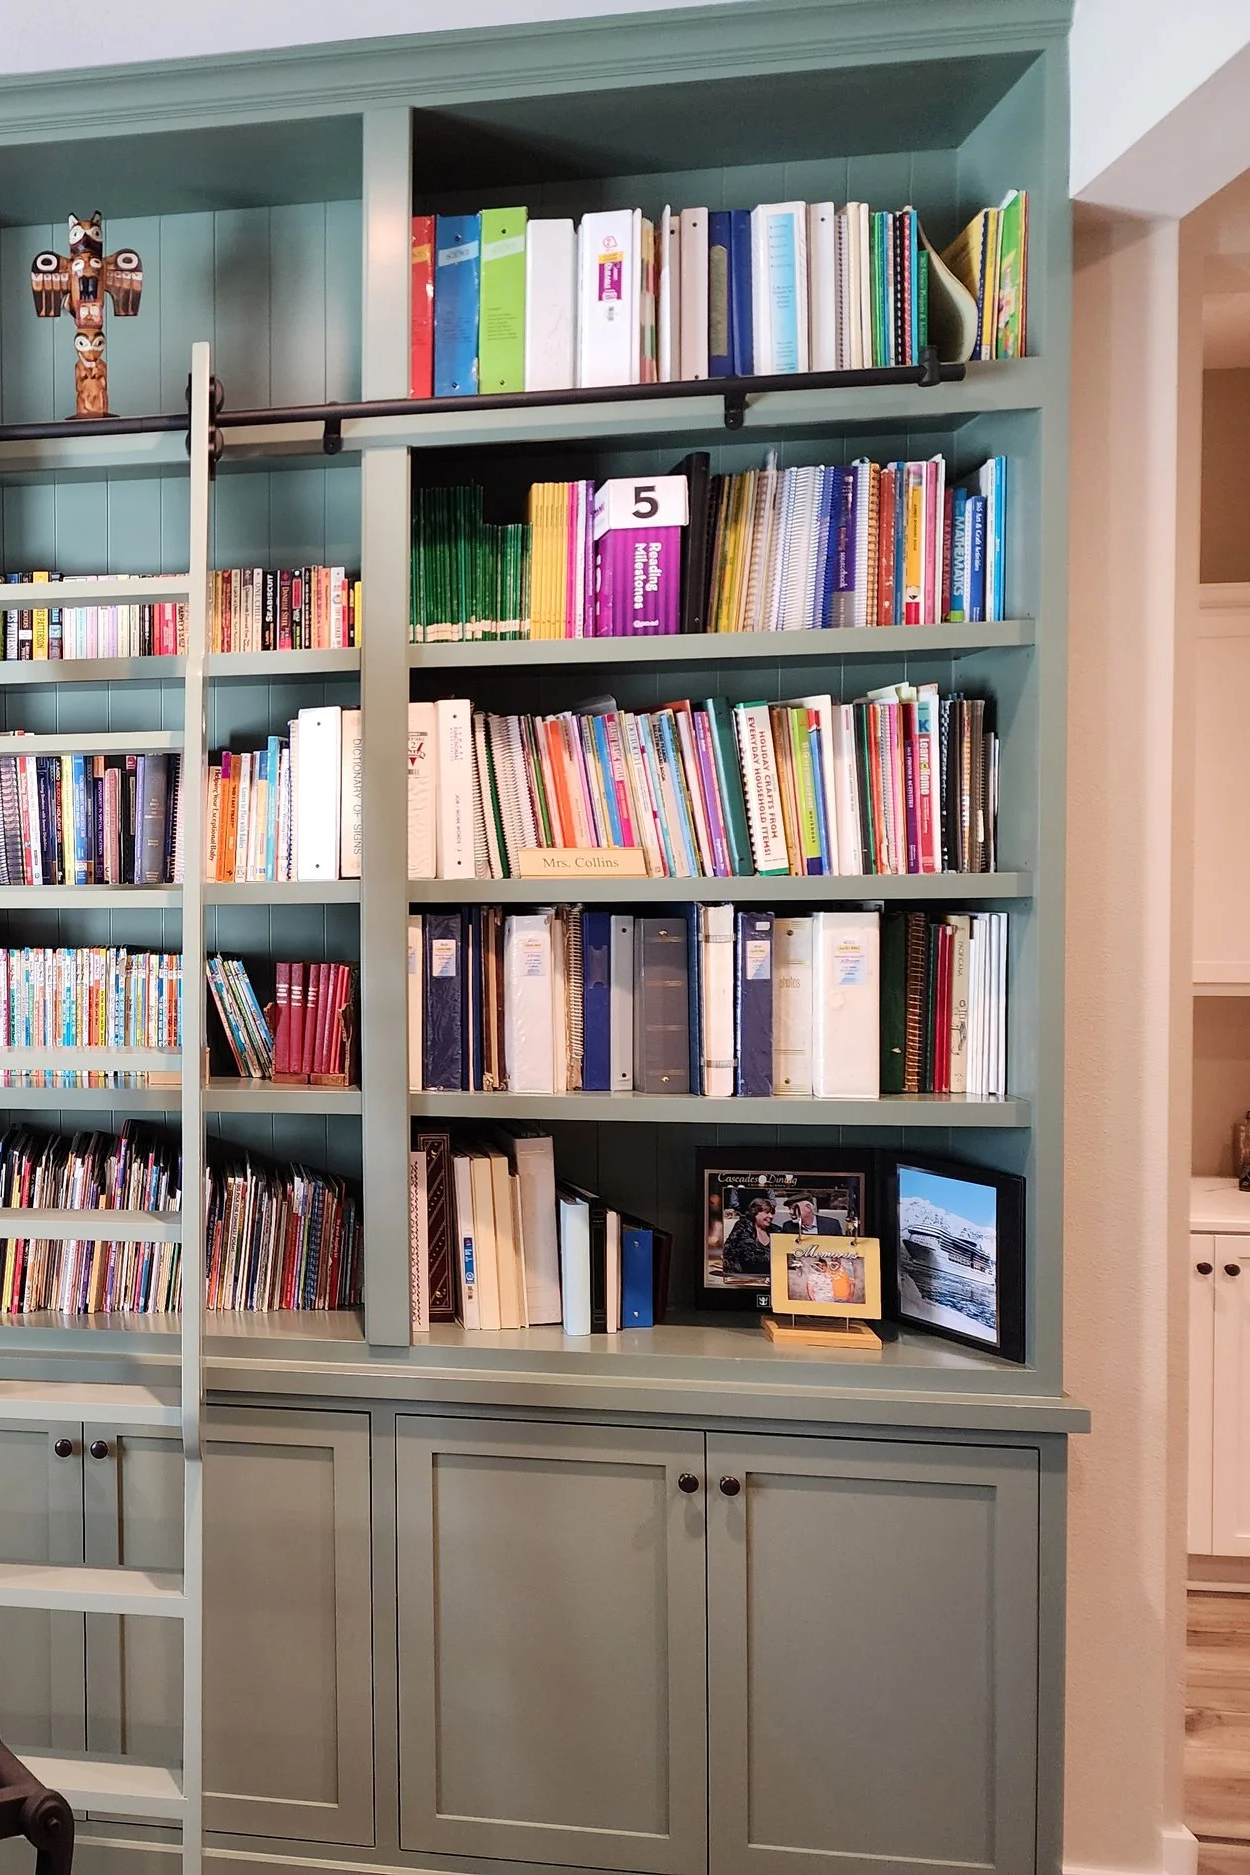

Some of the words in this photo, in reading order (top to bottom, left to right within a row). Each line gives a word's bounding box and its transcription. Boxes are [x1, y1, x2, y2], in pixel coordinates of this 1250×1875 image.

[632, 486, 658, 519] 5
[646, 542, 662, 592] Reading
[840, 552, 848, 588] sourcebook
[954, 517, 966, 596] MATHEMATICS
[634, 543, 647, 610] Milestones
[266, 574, 274, 622] SEABISCUIT
[7, 623, 18, 659] PATTERSON
[353, 738, 362, 798] DICTIONARY
[759, 731, 770, 771] HOLIDAY
[919, 738, 929, 764] Learn
[212, 768, 220, 792] Helping
[748, 717, 760, 765] EVERYDAY
[755, 768, 766, 823] HOUSEHOLD
[762, 827, 770, 856] ITEMS!
[766, 775, 774, 810] CRAFTS
[920, 769, 930, 795] Home
[210, 808, 218, 844] Exceptional
[354, 804, 362, 818] OF
[769, 813, 778, 838] FROM
[208, 846, 216, 862] Baby
[354, 824, 362, 855] SIGNS
[542, 858, 570, 868] Mrs.
[574, 858, 619, 868] Collins
[718, 1172, 758, 1183] Cascades
[766, 1174, 798, 1186] Dining
[793, 1244, 858, 1260] Memories
